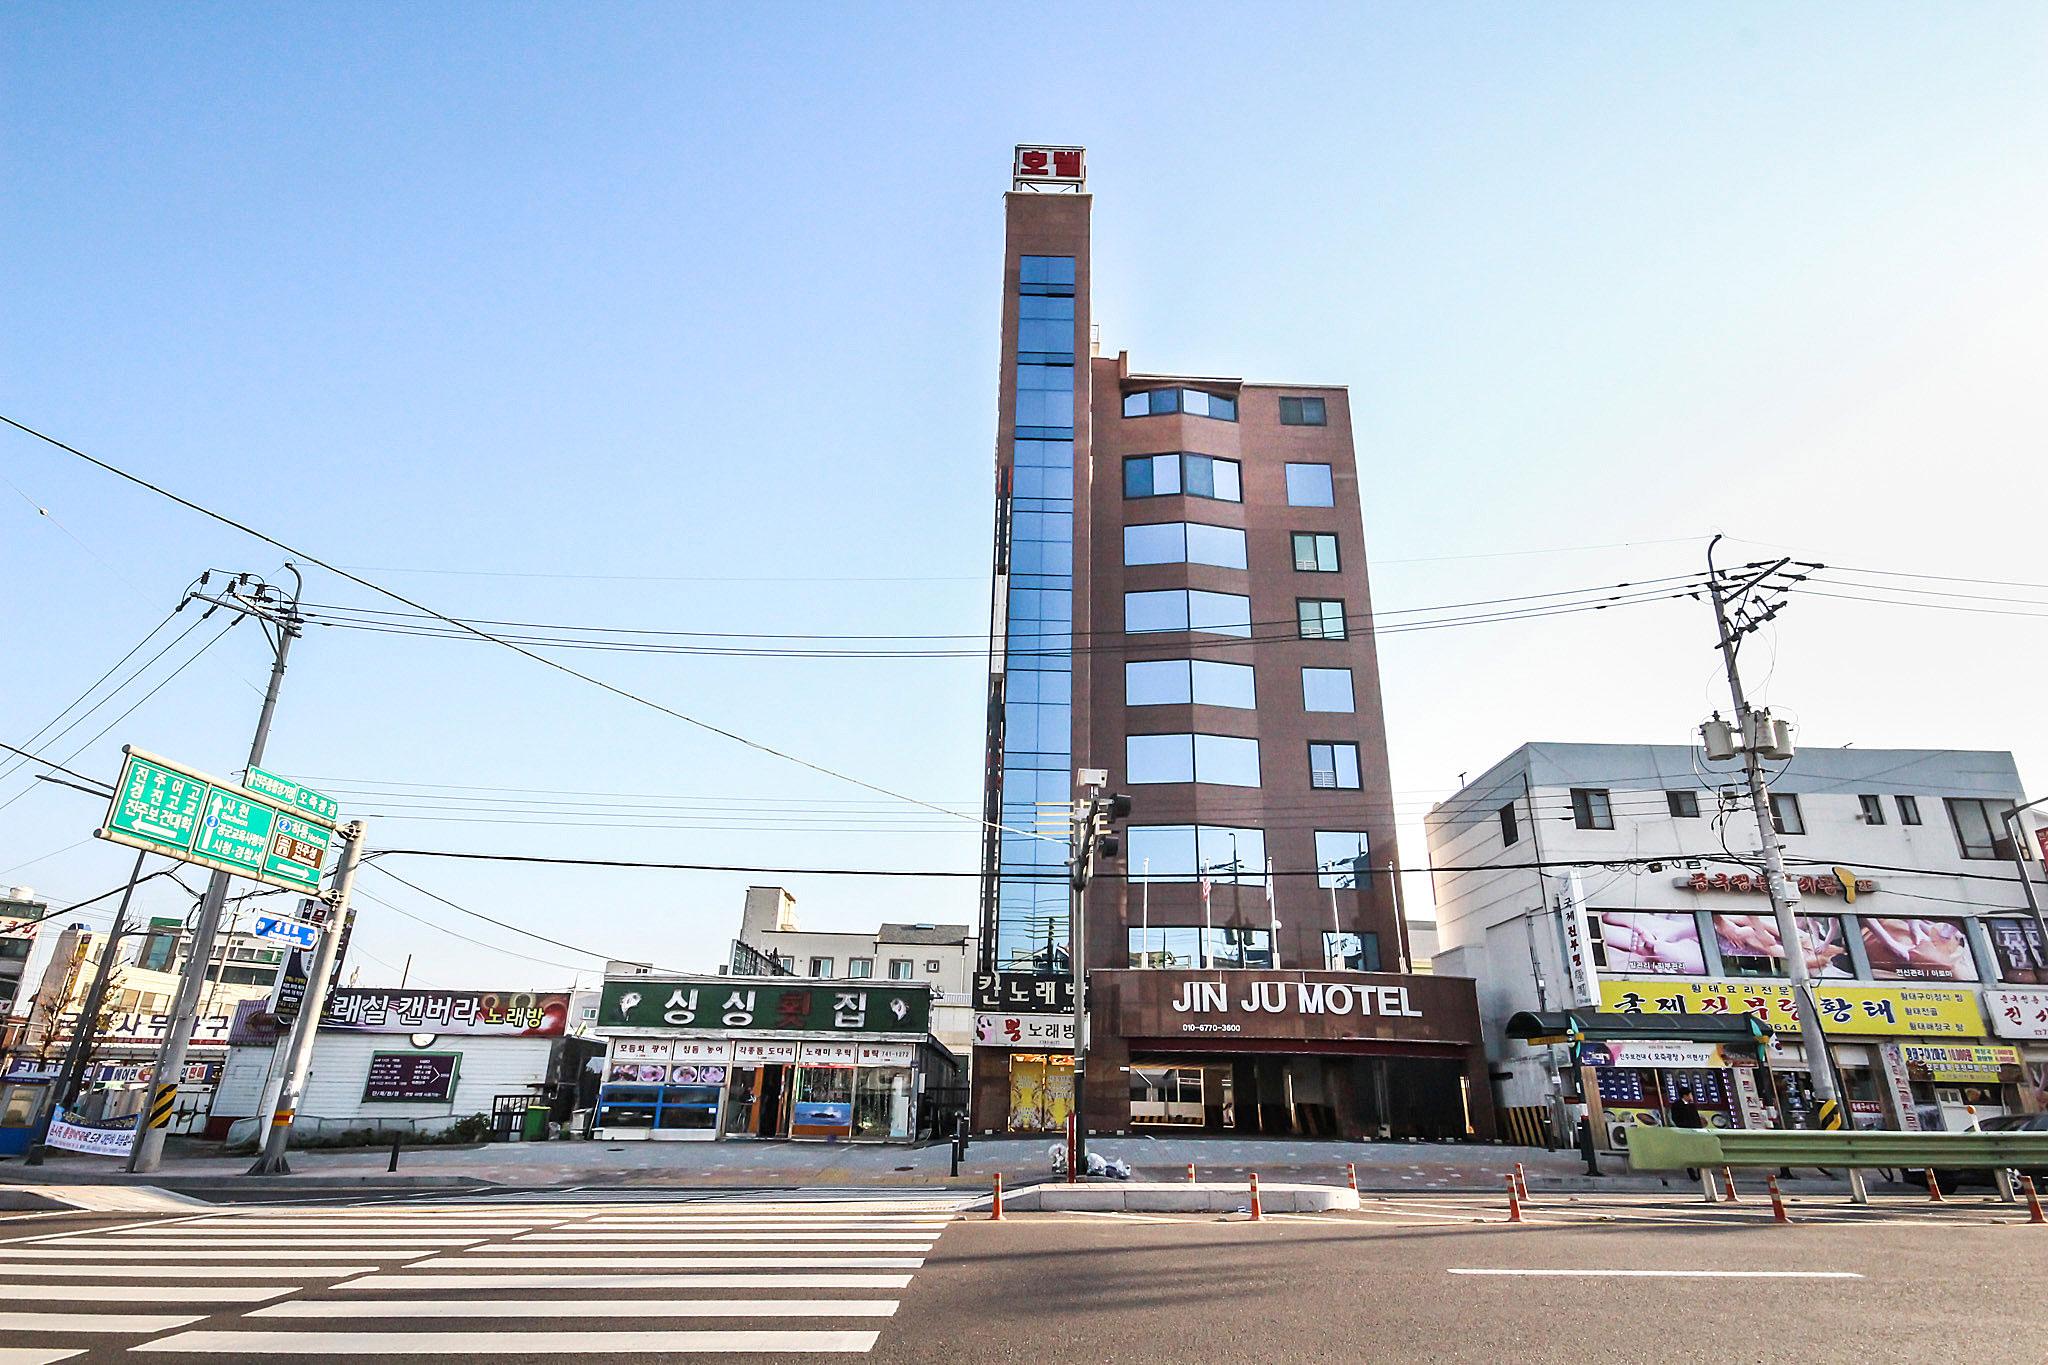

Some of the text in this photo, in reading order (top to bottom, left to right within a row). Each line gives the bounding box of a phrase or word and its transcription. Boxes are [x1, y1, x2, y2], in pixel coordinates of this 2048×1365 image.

[1021, 151, 1080, 177] 호텔
[222, 800, 250, 818] 사천
[209, 816, 217, 827] 3
[282, 821, 289, 829] 2
[1931, 970, 1953, 978] 아로마
[1173, 982, 1423, 1017] JIN JU MOTEL
[331, 995, 545, 1029] 래실 캔버라 노래방
[768, 1047, 794, 1056] 도다리
[805, 1048, 831, 1057] 노래미
